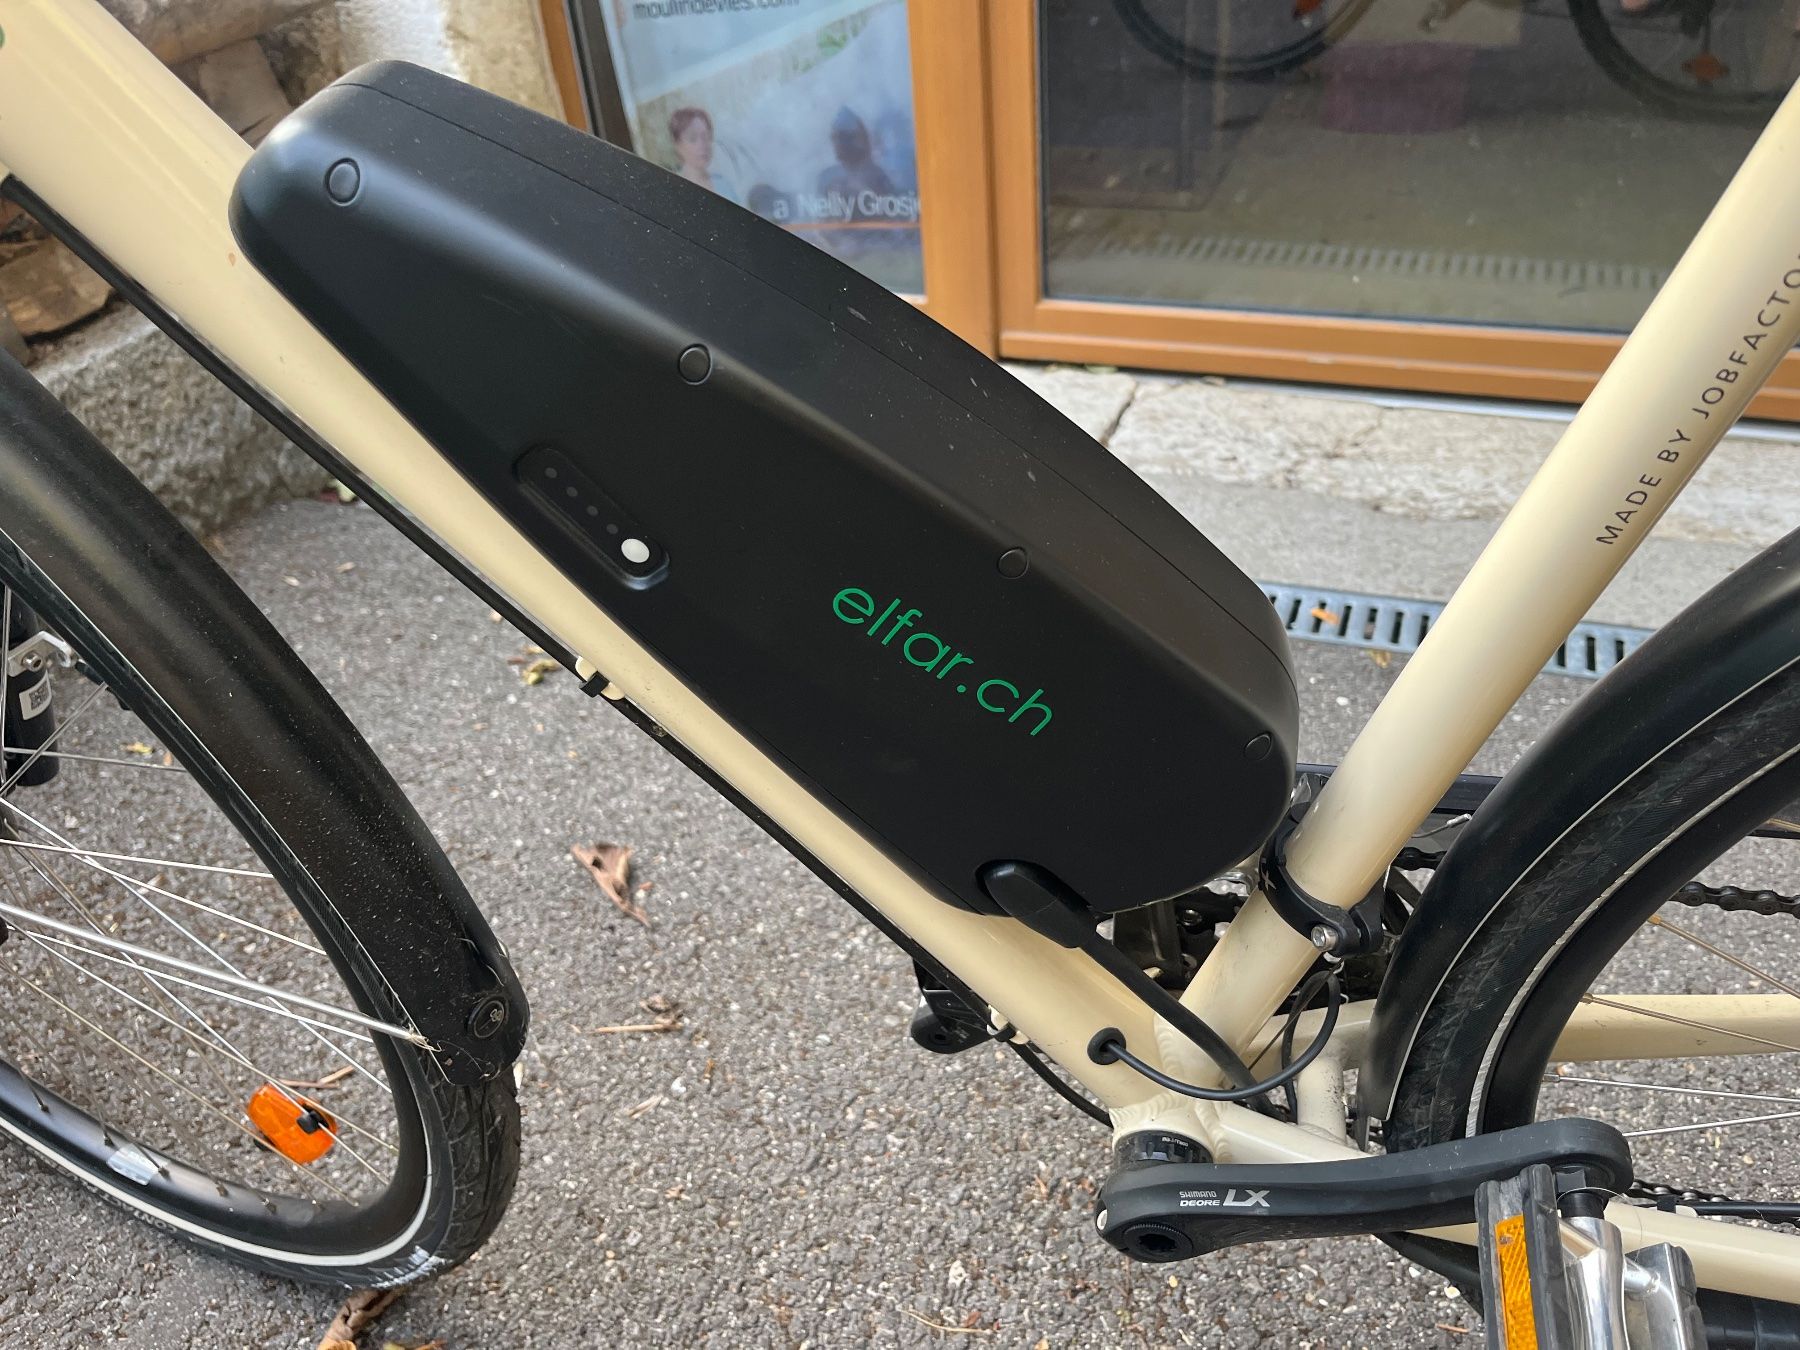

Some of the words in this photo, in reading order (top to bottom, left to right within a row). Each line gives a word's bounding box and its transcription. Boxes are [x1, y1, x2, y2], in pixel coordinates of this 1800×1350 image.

[797, 191, 855, 222] Nelly
[857, 190, 921, 221] Grosj
[1596, 474, 1662, 545] MADE
[1657, 429, 1691, 463] BY
[1692, 254, 1800, 420] JOBFACTO
[832, 587, 1053, 736] elfar.ch
[1223, 1188, 1270, 1208] LX
